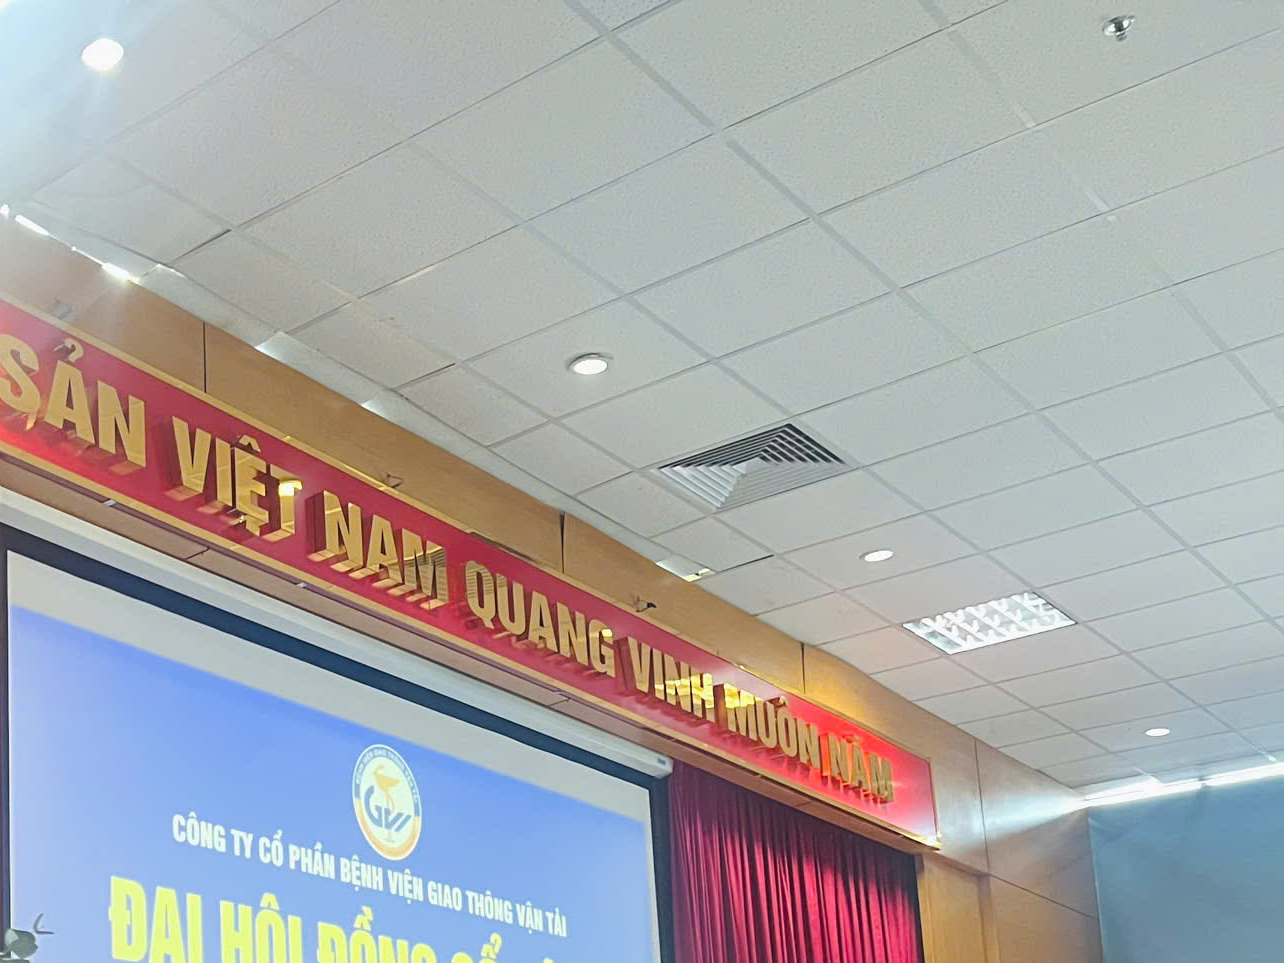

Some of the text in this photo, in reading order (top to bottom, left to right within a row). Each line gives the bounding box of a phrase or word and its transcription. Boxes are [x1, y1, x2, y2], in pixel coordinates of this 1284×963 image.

[172, 416, 302, 536] VIỆT
[323, 490, 449, 604] NAM
[464, 560, 615, 679] QUANG
[628, 636, 715, 724] VINH
[724, 683, 821, 769] MUÔN
[828, 733, 894, 803] NĂM
[172, 811, 227, 853] CÔNG
[230, 828, 254, 859] TY
[258, 829, 284, 867] CỔ
[288, 841, 336, 880] PHẦN
[339, 854, 384, 892] BỆNH
[387, 868, 424, 905] VIỆN
[427, 880, 463, 912] GIAO
[465, 890, 513, 925] THÔNG
[515, 901, 544, 934] VẬN
